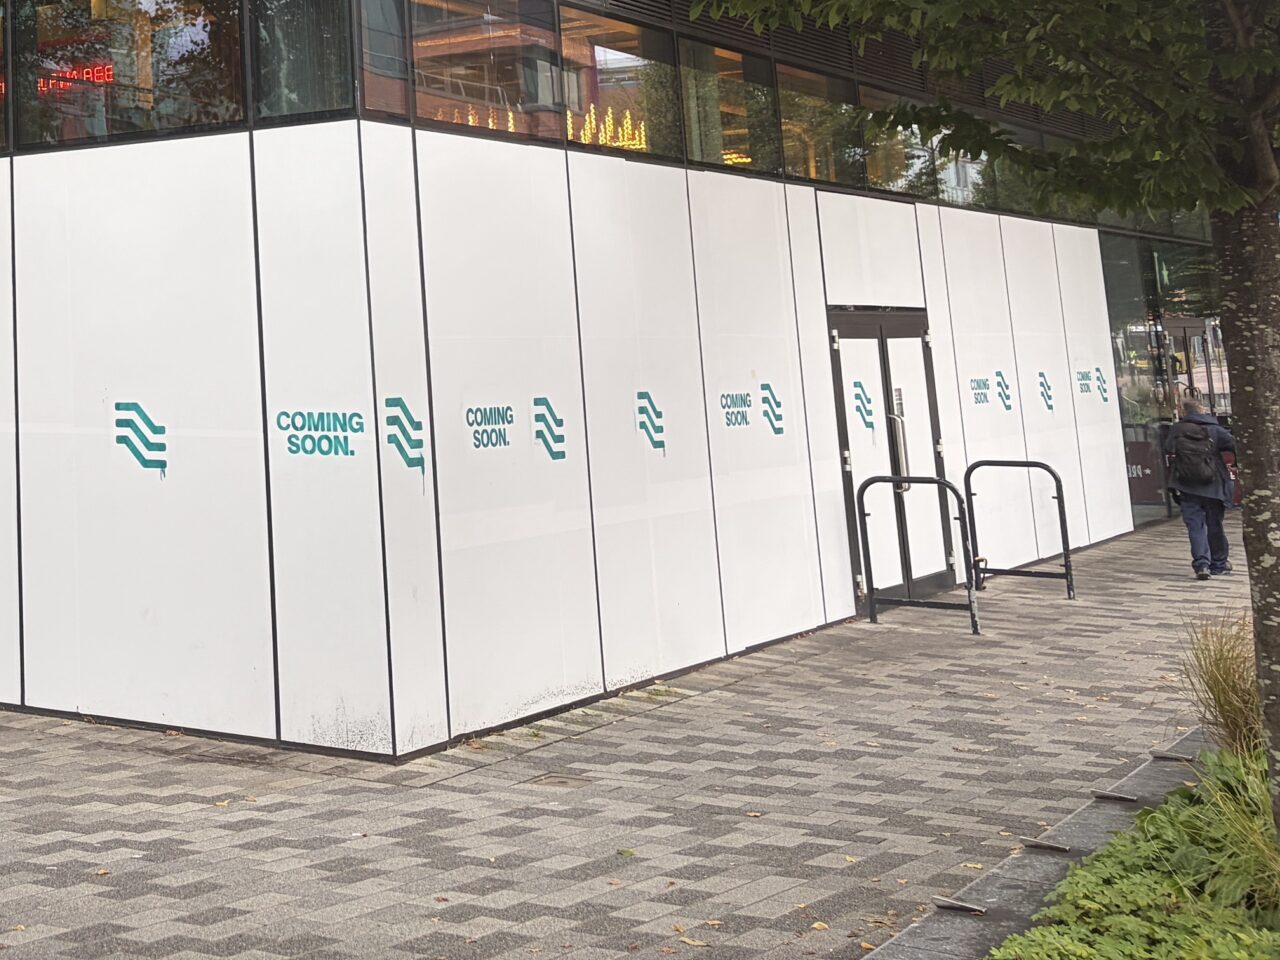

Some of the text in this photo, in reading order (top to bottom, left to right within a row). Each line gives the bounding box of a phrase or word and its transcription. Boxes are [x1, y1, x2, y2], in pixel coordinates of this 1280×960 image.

[720, 393, 752, 409] COMING
[276, 411, 365, 433] COMING
[465, 406, 514, 427] COMING
[287, 434, 356, 456] SOON.
[472, 428, 510, 448] SOON.
